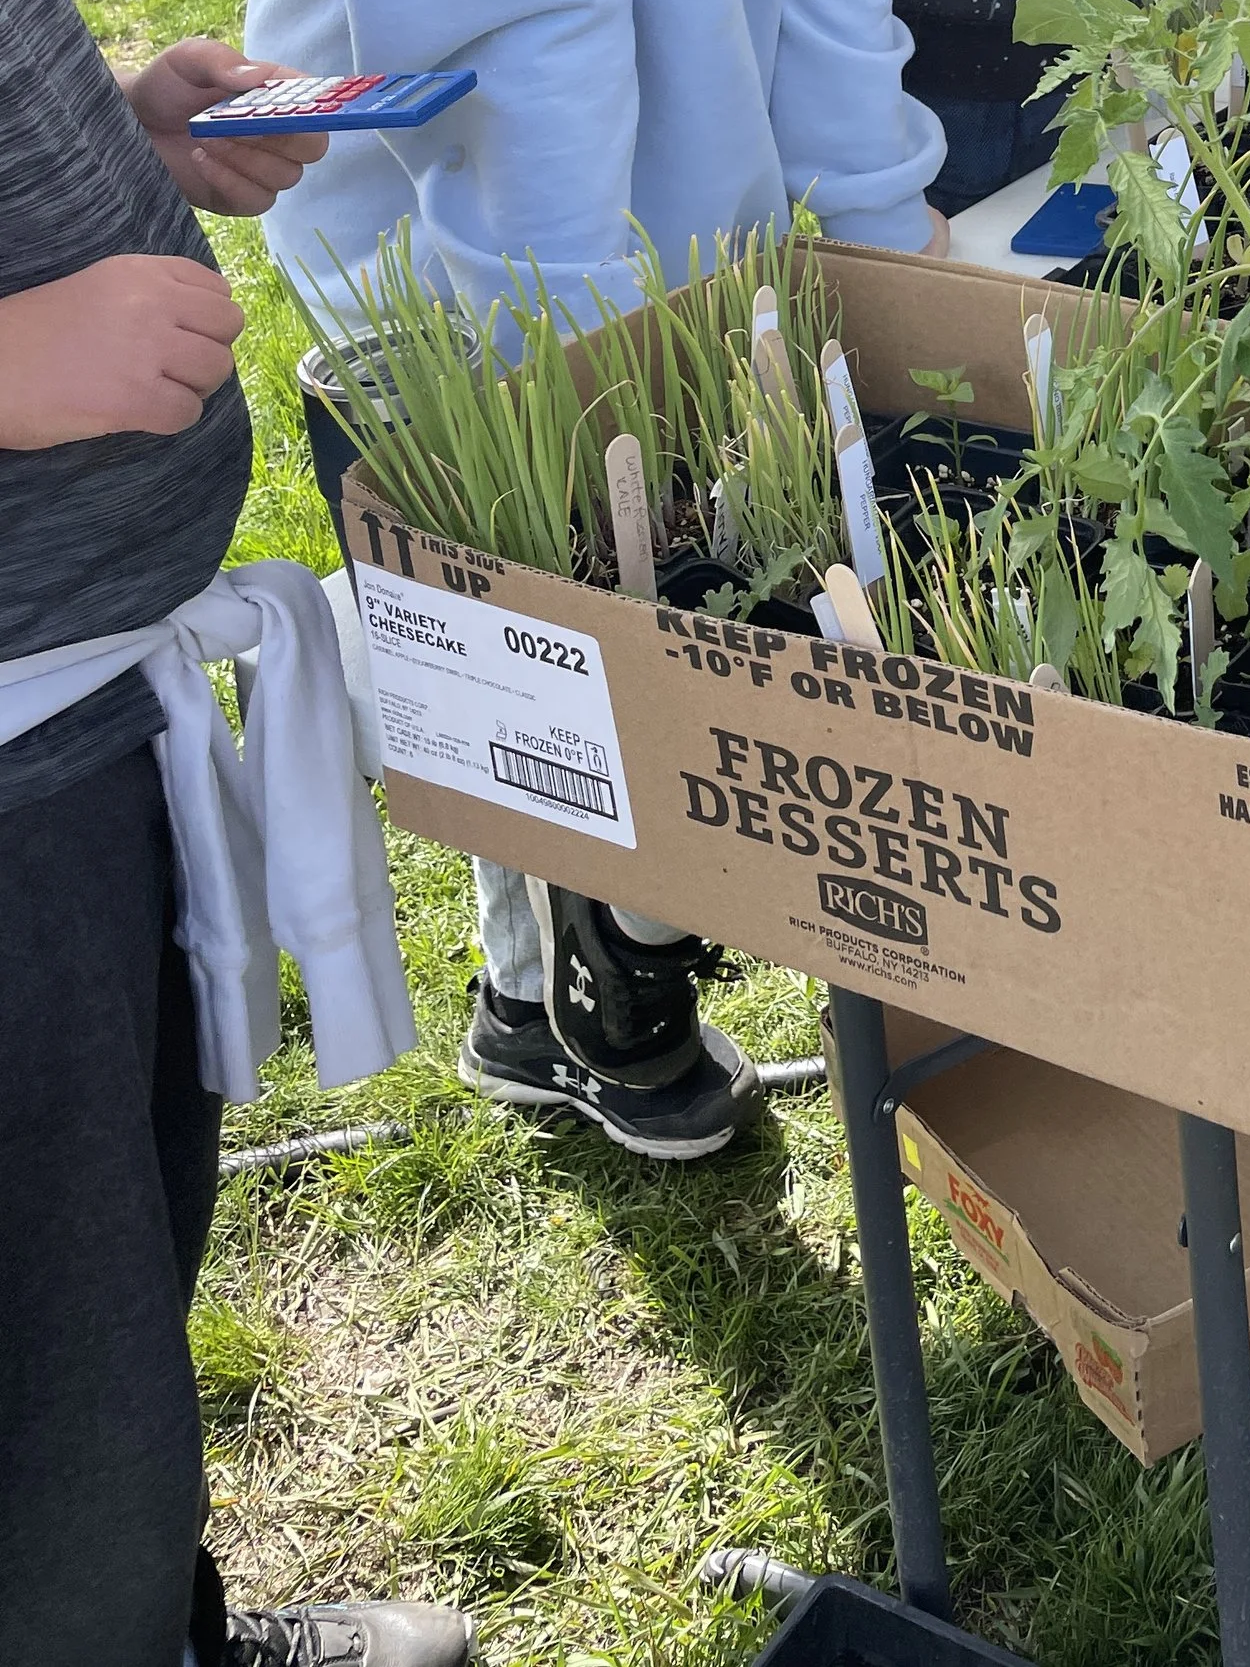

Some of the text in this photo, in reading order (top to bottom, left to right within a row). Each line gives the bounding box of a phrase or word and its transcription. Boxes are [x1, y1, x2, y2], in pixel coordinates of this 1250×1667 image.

[859, 493, 871, 532] PEPPER
[441, 562, 491, 599] UP
[369, 613, 467, 657] CHEESECAKE
[384, 601, 447, 634] VARIETY
[504, 625, 590, 677] 00222
[656, 607, 1035, 727] KEEP FROZEN
[665, 643, 1034, 758] -10°F OR BELOW
[515, 730, 584, 764] FROZEN 0°F
[549, 725, 581, 746] KEEP
[709, 726, 1010, 860] FROZEN
[679, 771, 1062, 934] DESSERTS
[822, 879, 925, 938] RICH'S
[789, 916, 966, 985] RICH PRODUCTS CORPORATION
[825, 937, 930, 983] BUFFALO, NY 14213
[838, 954, 918, 990] www.richs.com
